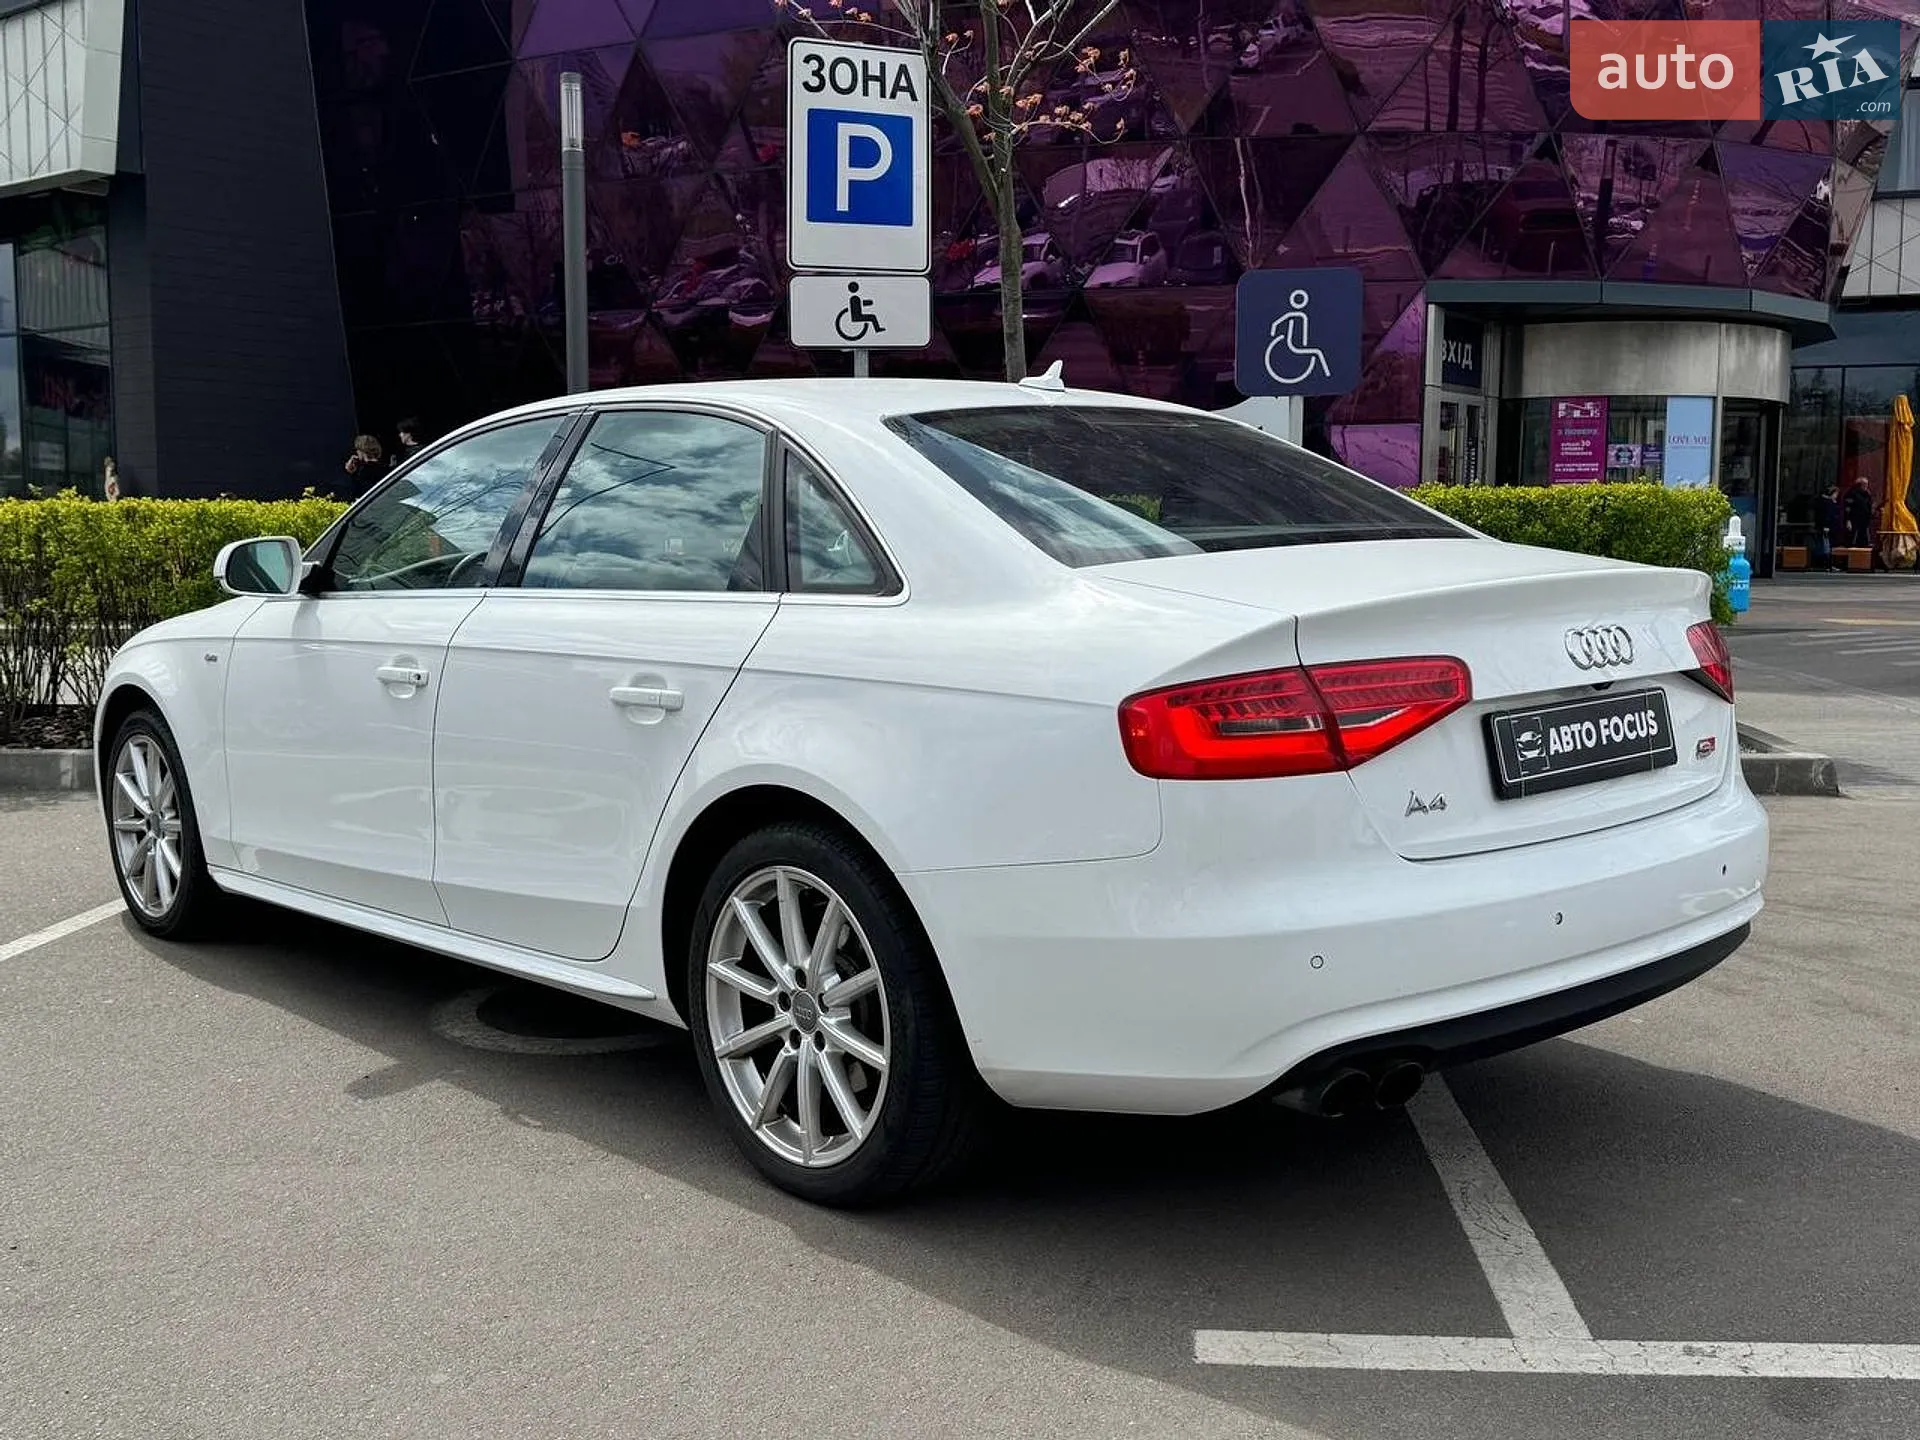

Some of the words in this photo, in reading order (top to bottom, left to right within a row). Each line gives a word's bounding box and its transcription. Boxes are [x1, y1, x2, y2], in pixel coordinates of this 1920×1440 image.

[801, 53, 918, 102] ЗОНА
[836, 121, 894, 212] P
[1548, 721, 1597, 756] АВТО
[1600, 710, 1658, 745] FOCUS
[1404, 790, 1448, 817] A4
